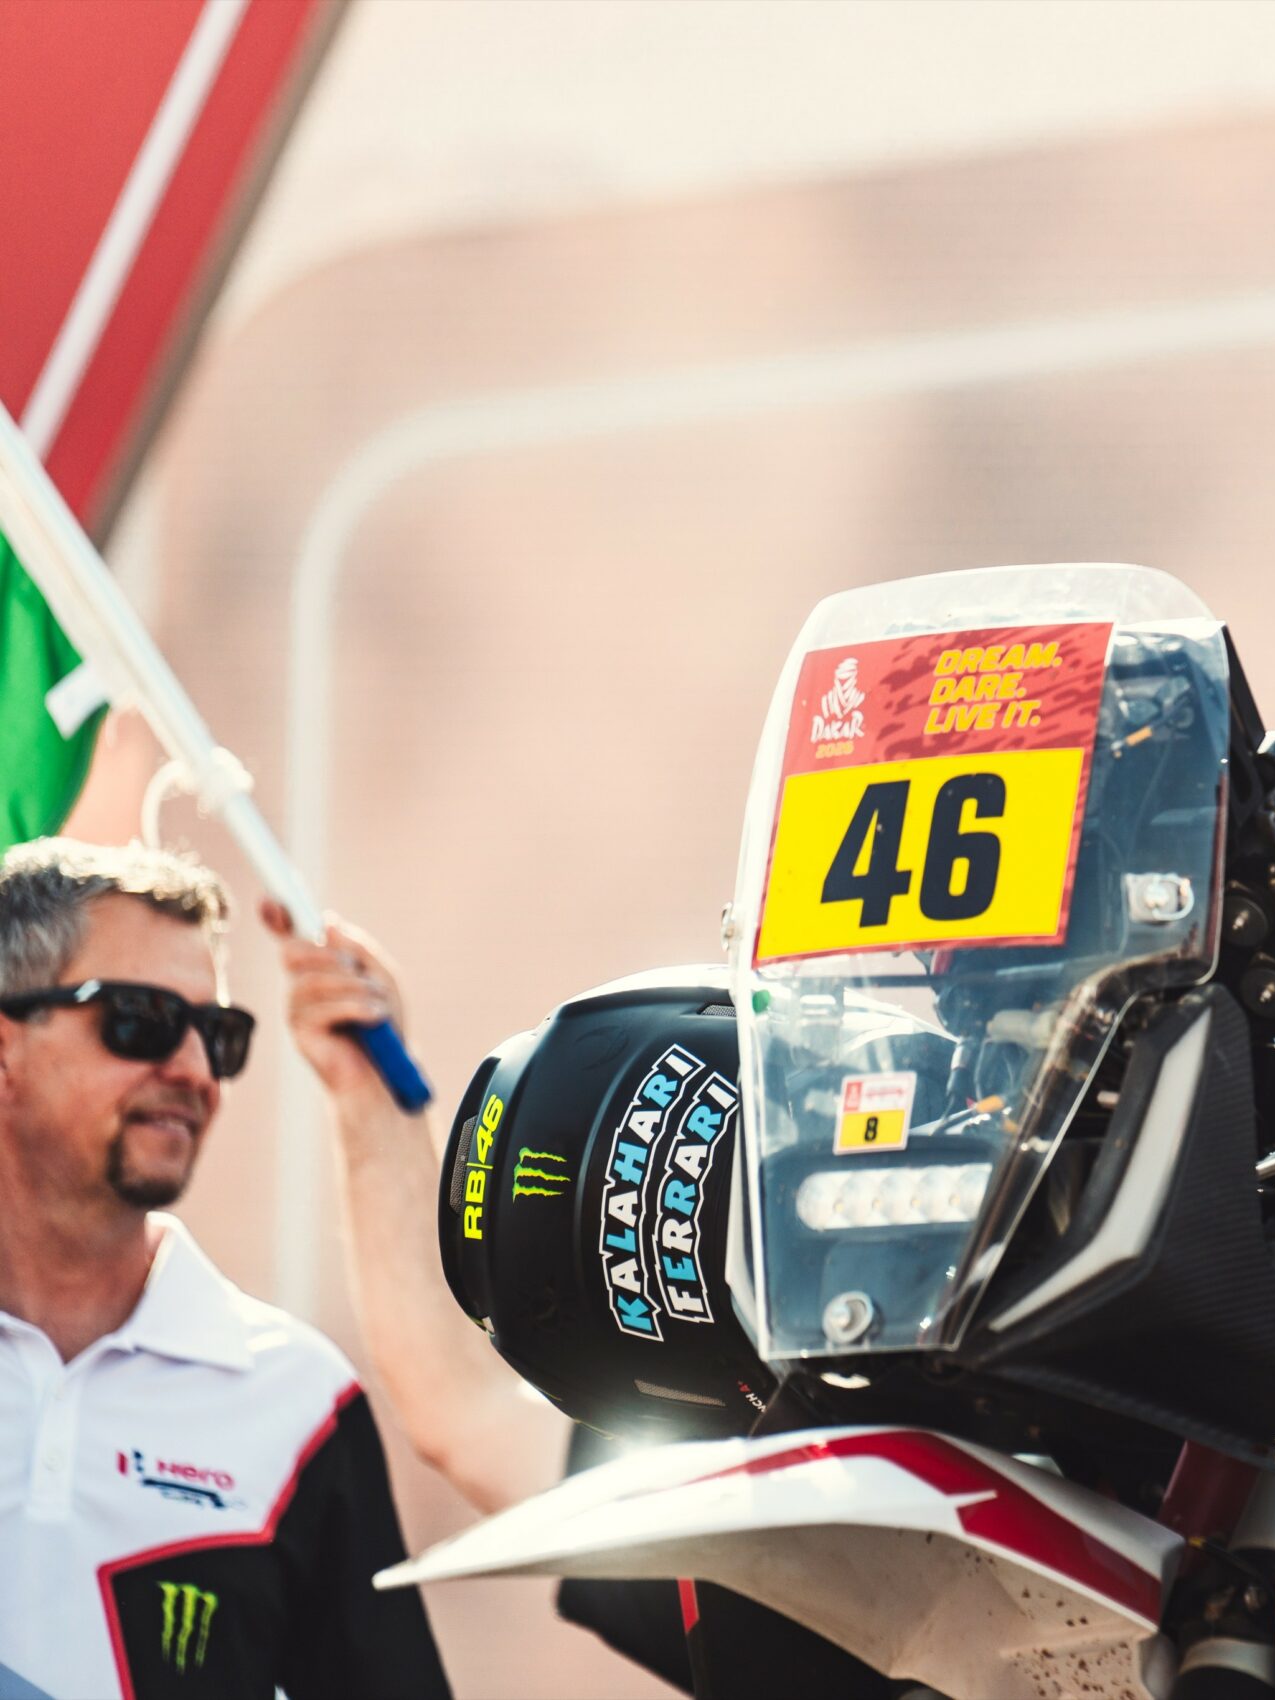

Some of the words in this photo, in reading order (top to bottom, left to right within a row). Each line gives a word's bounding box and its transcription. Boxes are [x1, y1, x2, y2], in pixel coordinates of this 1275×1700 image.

[933, 641, 1063, 675] DREAM.
[928, 672, 1026, 705] DARE.
[810, 711, 864, 743] DAKAR
[923, 702, 1001, 735] LIVE
[1000, 699, 1041, 729] IT.
[820, 773, 1007, 928] 46
[864, 1116, 879, 1142] 8
[604, 1052, 696, 1334] KALAHARI
[660, 1082, 737, 1315] FERRARI
